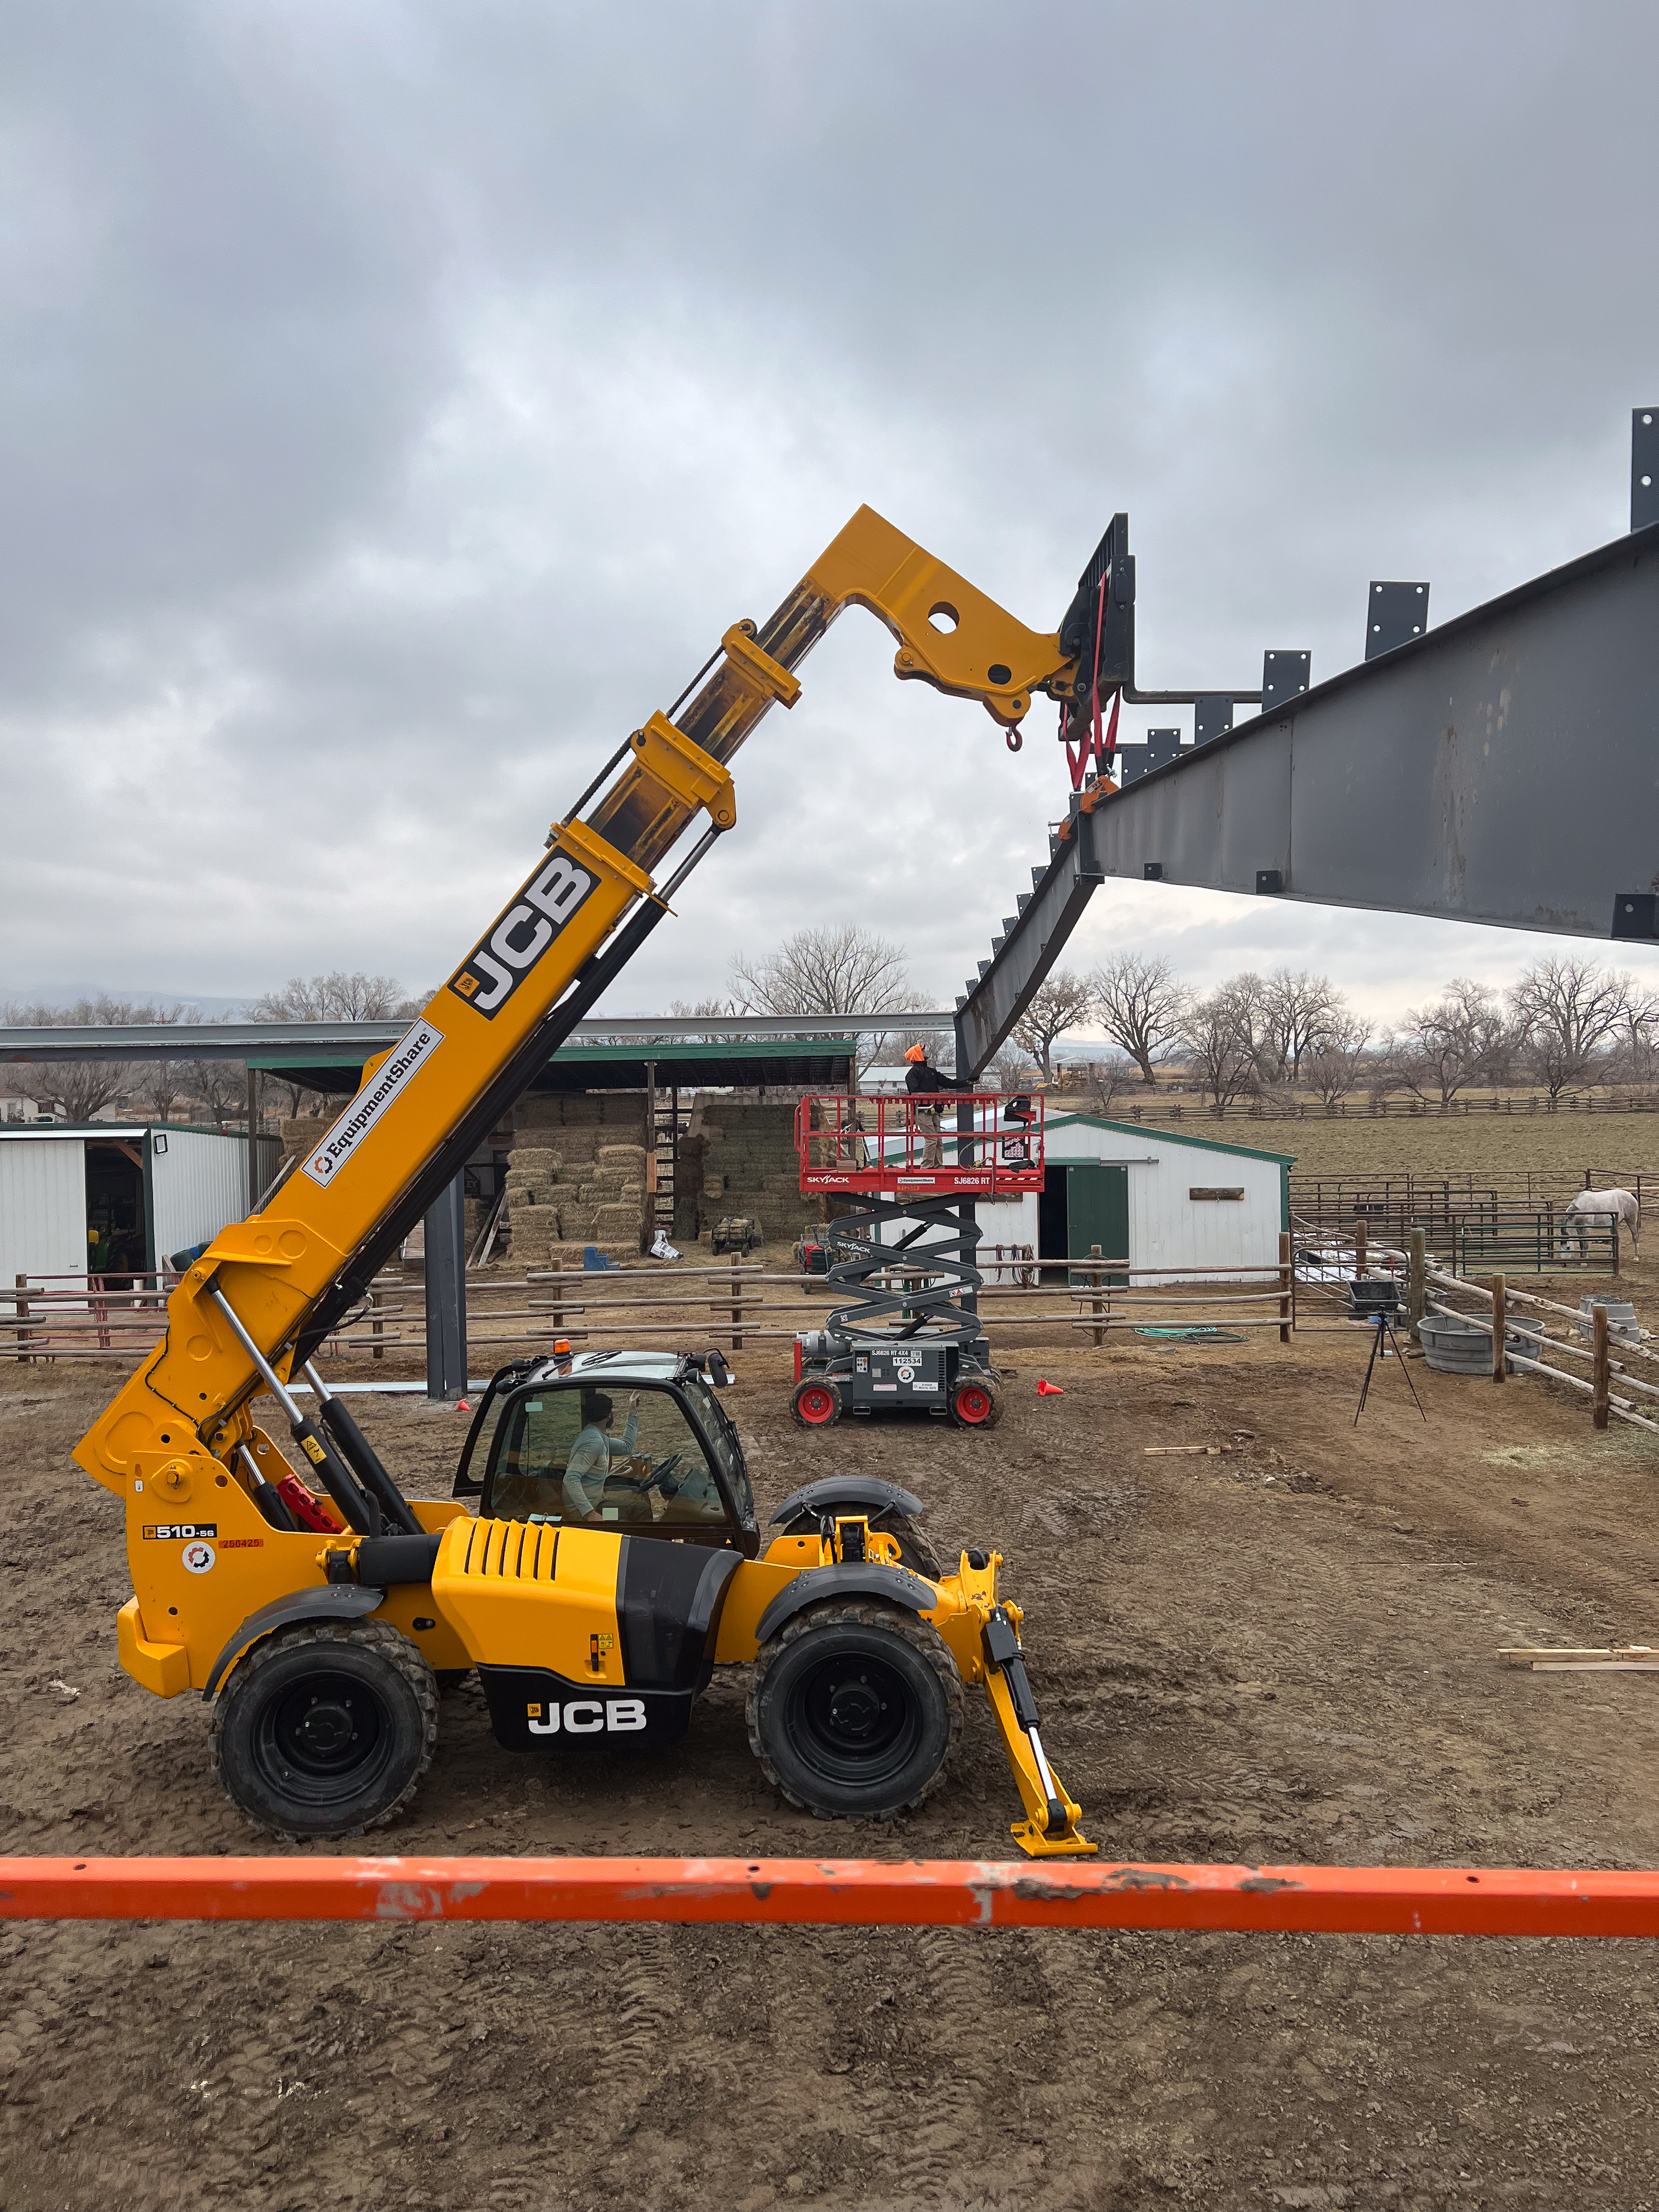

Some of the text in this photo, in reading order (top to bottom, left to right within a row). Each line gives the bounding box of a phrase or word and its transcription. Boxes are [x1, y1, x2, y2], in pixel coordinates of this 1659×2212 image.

[473, 857, 591, 1009] JCB
[326, 1033, 431, 1159] EquipmentShare
[807, 1175, 850, 1184] SKYJACK
[837, 1241, 871, 1254] SKYJACK
[528, 1699, 647, 1734] JCB
